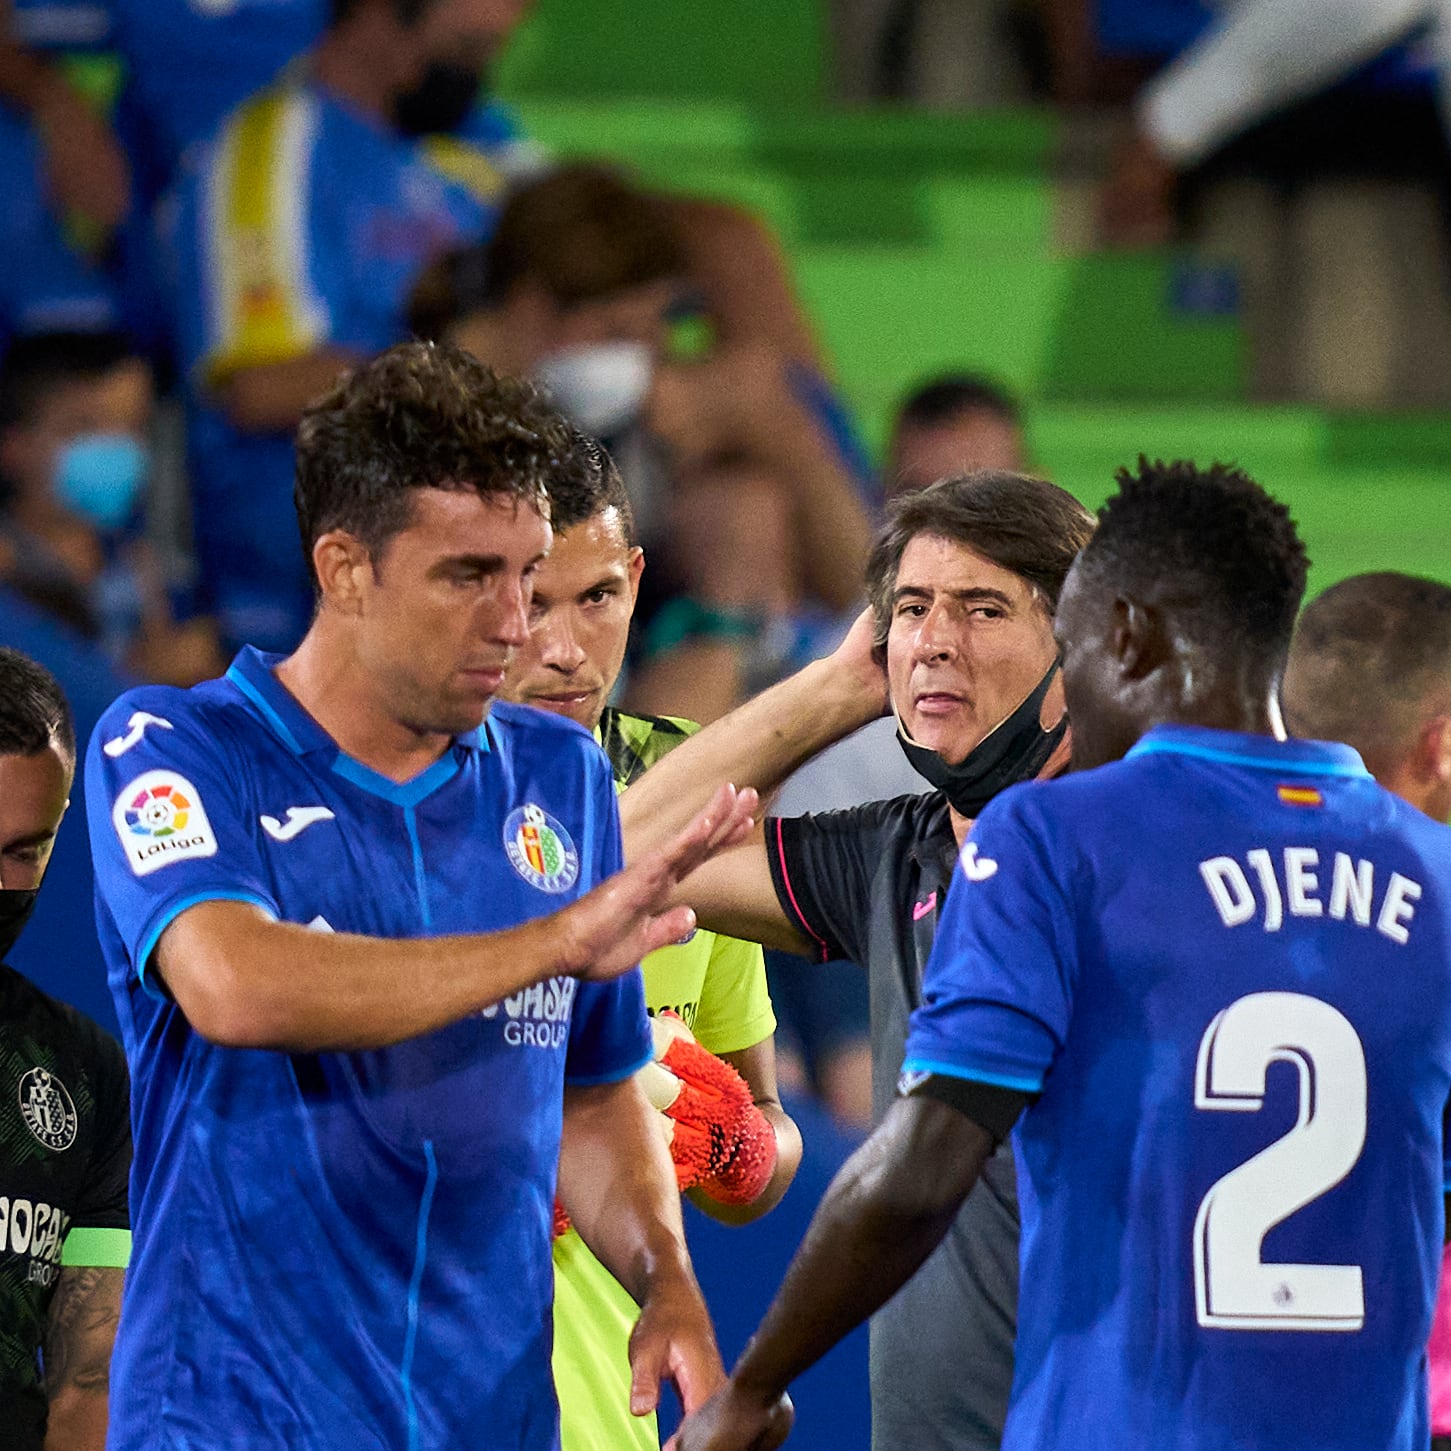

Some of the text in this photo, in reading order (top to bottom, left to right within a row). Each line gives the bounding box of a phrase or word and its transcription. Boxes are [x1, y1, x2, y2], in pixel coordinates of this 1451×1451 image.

[137, 836, 205, 861] LaLiga
[1199, 847, 1423, 946] DJENE
[1193, 990, 1368, 1332] 2
